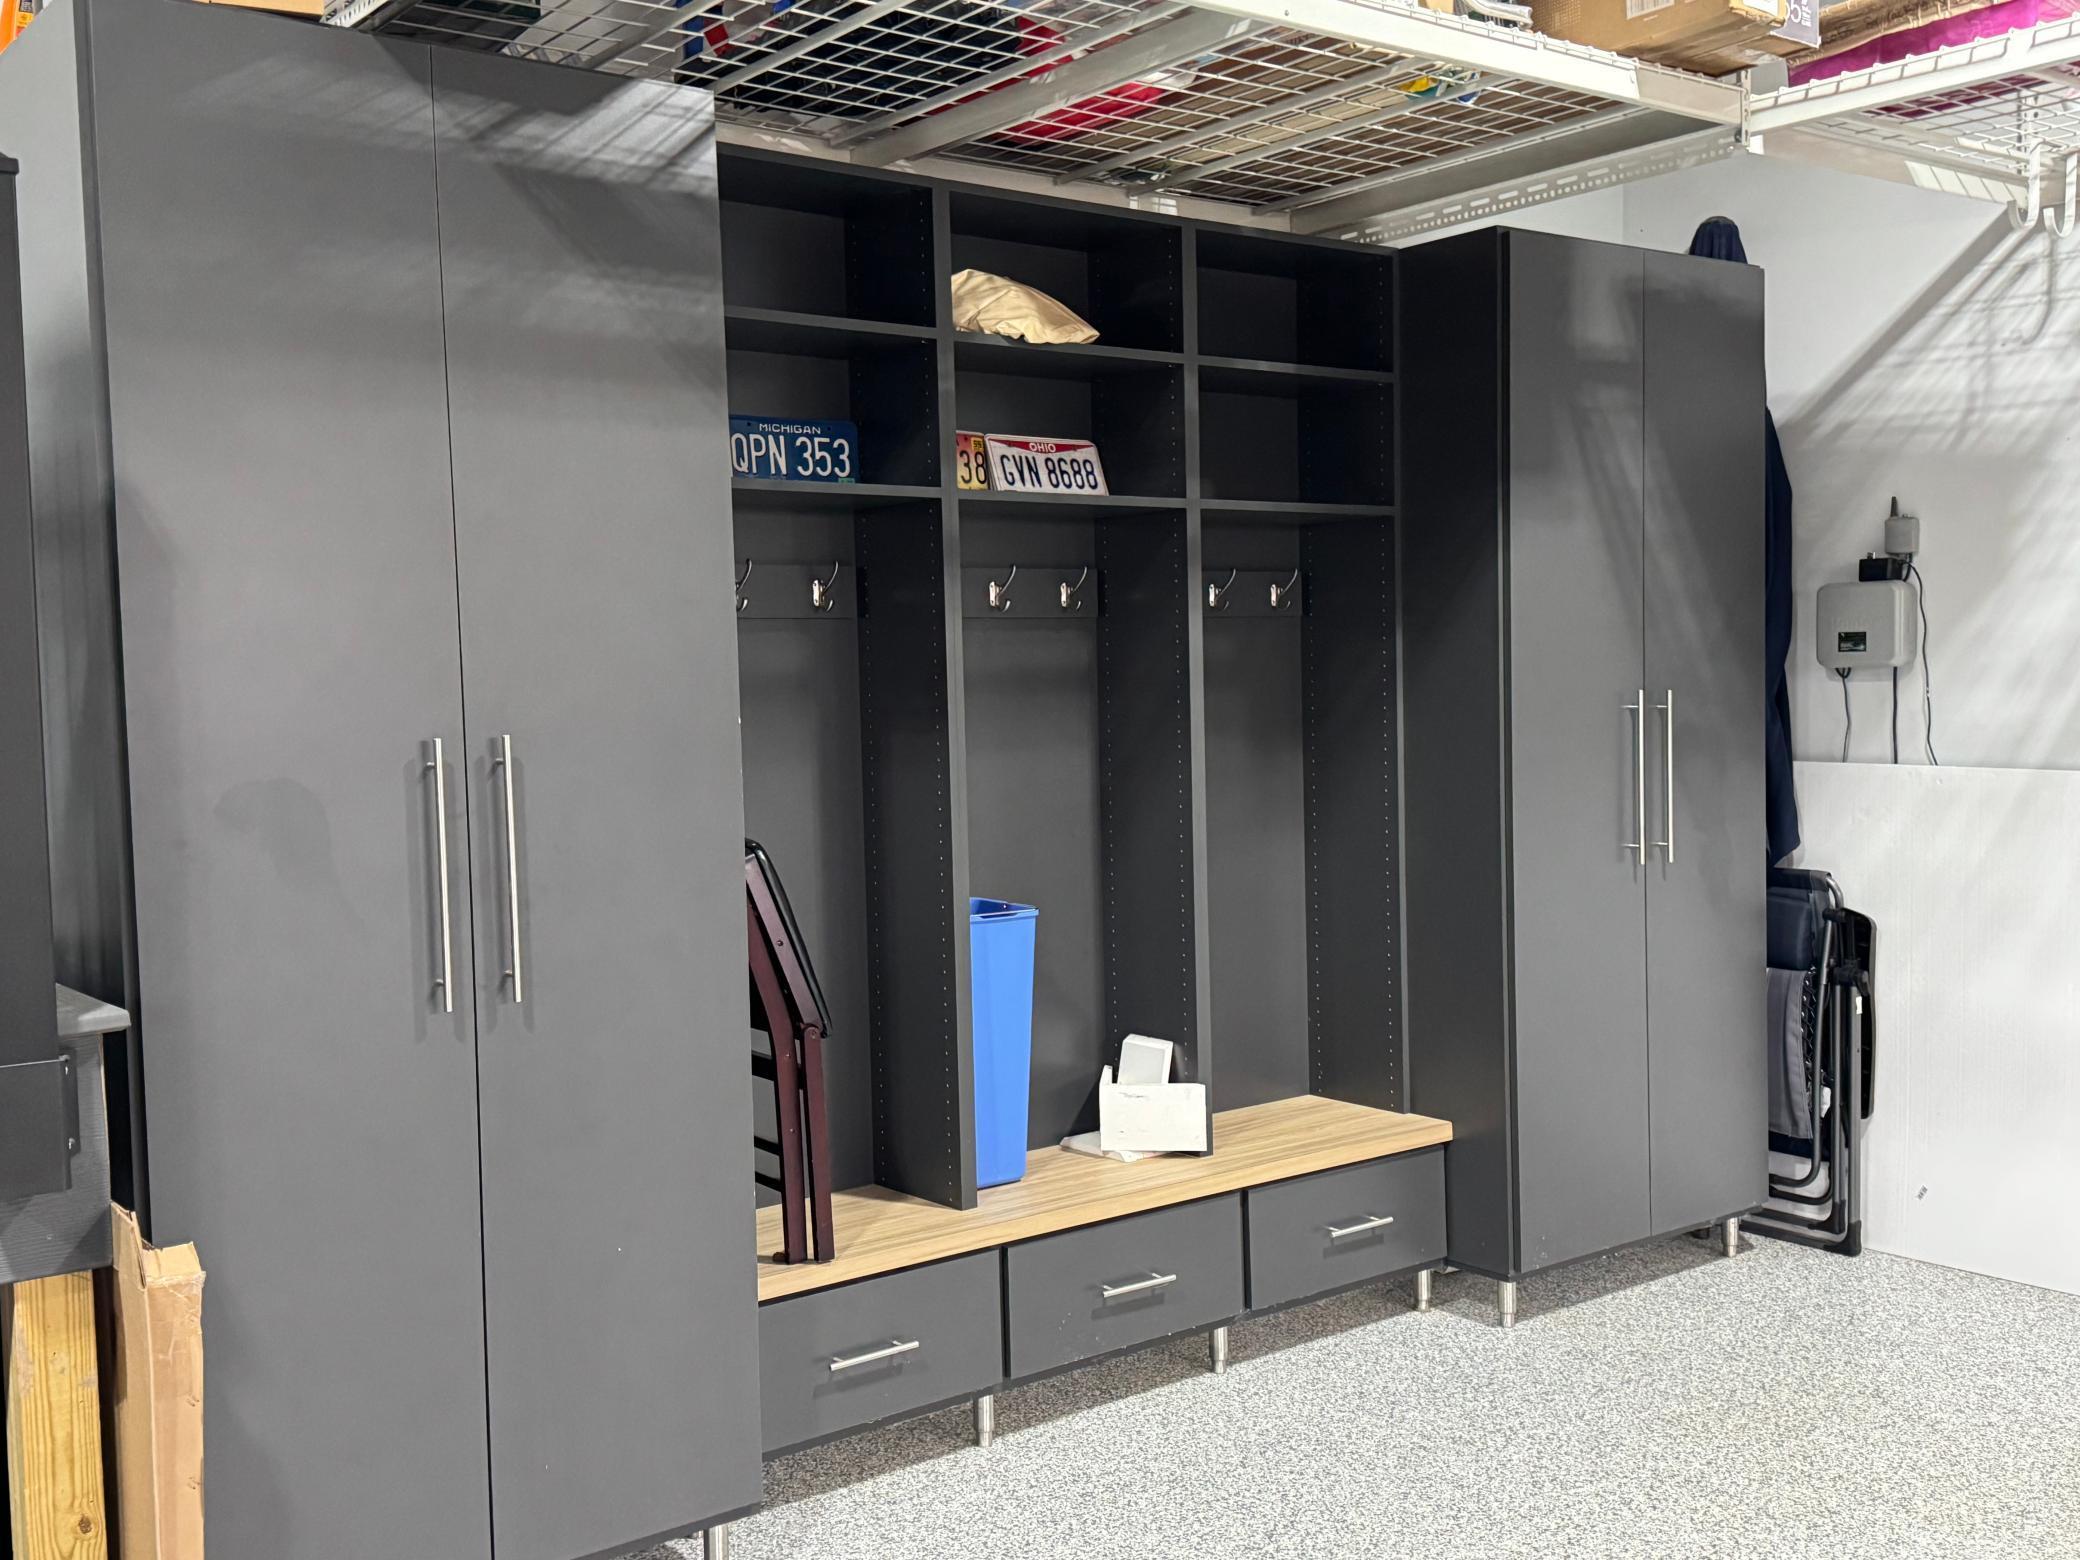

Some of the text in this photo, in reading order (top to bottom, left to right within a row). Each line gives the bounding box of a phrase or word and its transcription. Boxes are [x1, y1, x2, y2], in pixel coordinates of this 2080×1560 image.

[759, 423, 821, 434] MICHIGAN
[731, 433, 850, 477] QPN 353
[1028, 442, 1057, 453] OHIO
[959, 450, 987, 485] 38
[1000, 454, 1098, 490] GVN 8688
